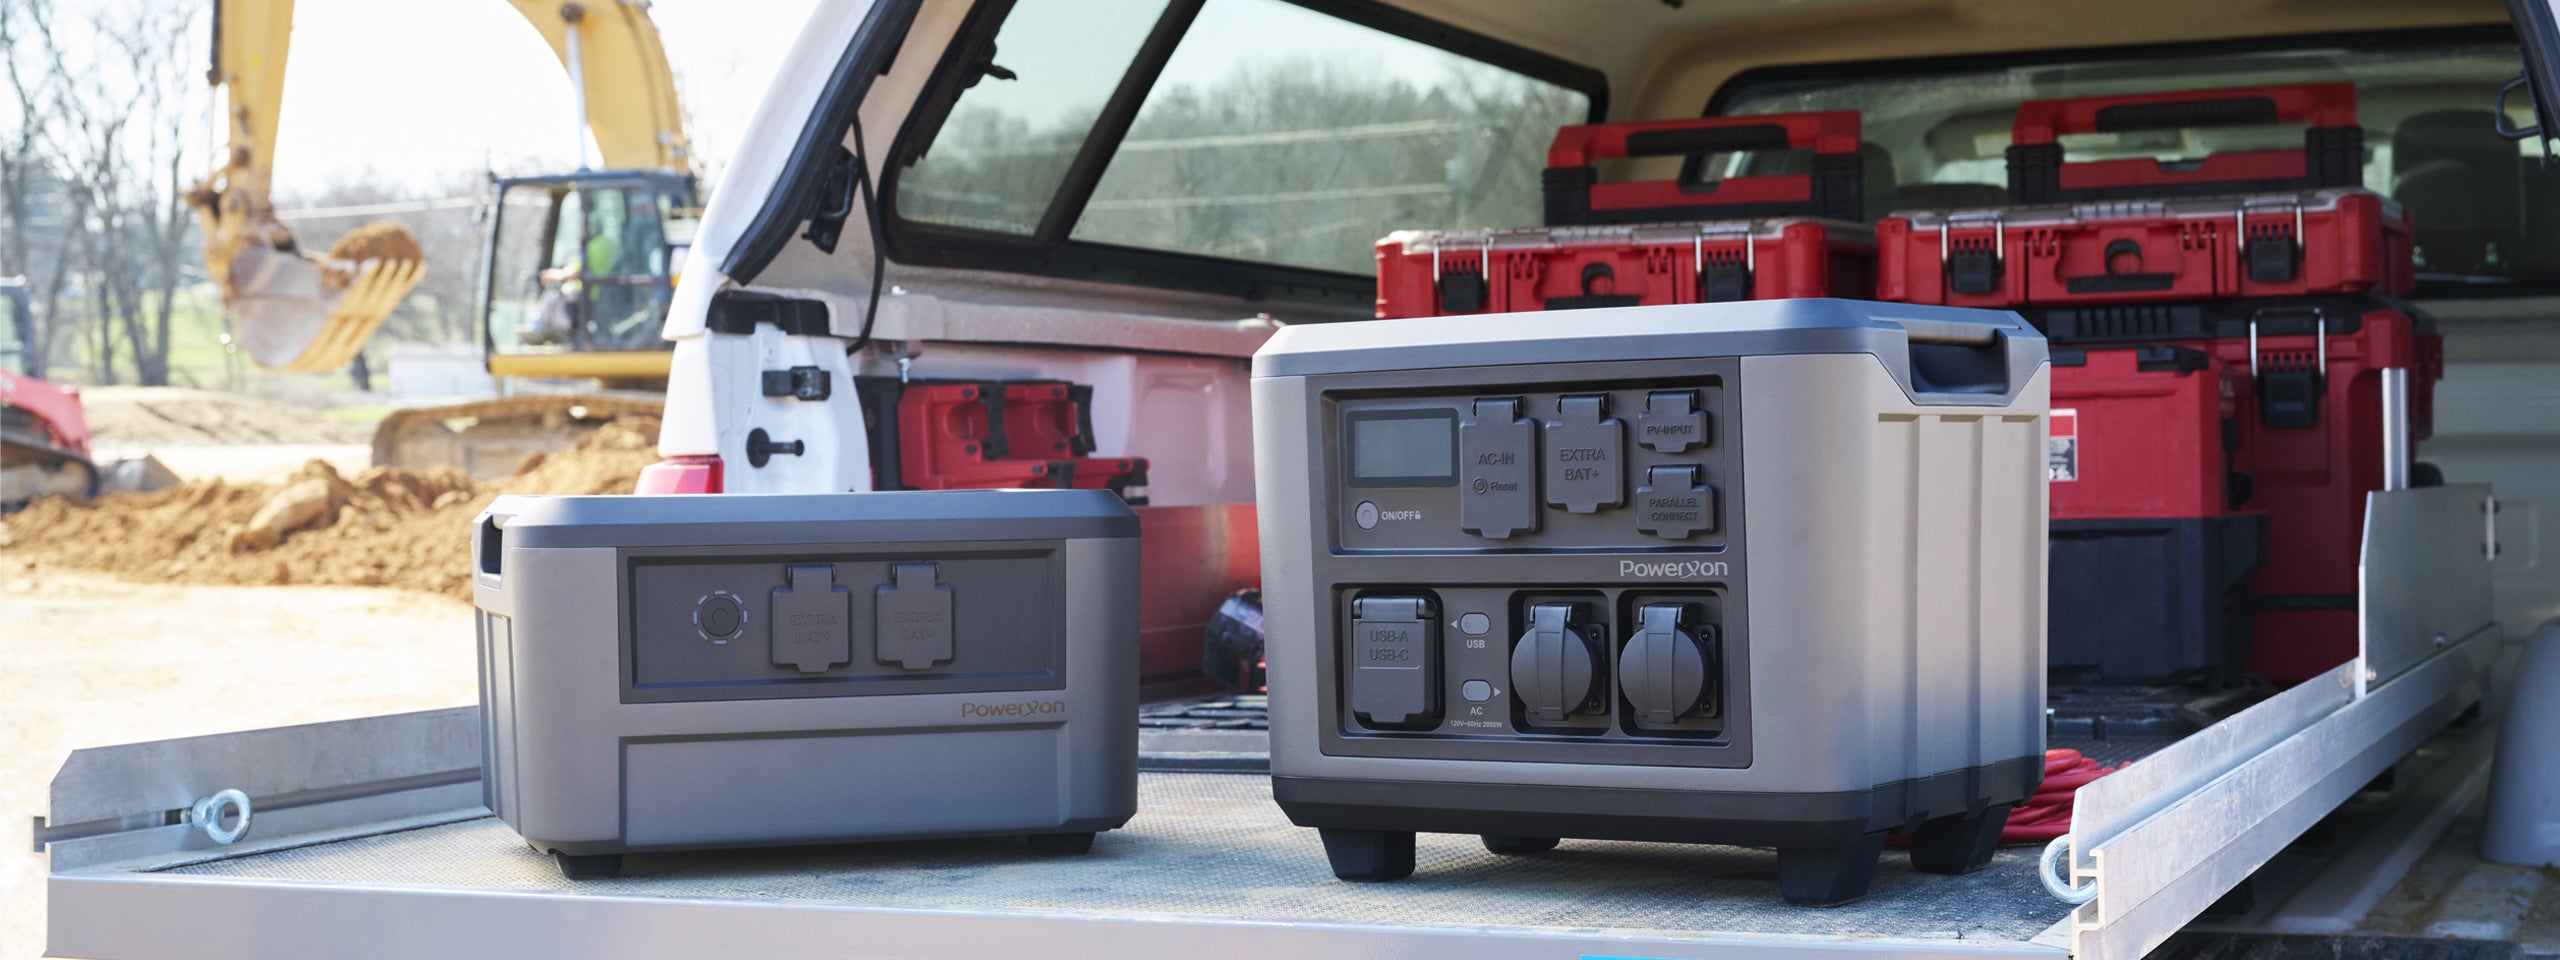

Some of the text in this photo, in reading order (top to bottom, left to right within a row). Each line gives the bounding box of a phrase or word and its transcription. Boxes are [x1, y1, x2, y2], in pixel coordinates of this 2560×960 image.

[1647, 424, 1693, 435] PV-INPUT
[1478, 452, 1515, 465] AC-IN
[1560, 448, 1606, 461] EXTRA
[1564, 468, 1600, 480] BAT+
[1490, 481, 1517, 492] Reset
[1649, 497, 1699, 508] PARALLEL
[1381, 510, 1415, 521] ON/OFF
[1651, 511, 1698, 521] CONNECT
[791, 613, 839, 626] EXTRA
[895, 611, 942, 623] EXTRA
[795, 631, 831, 643] BAT+
[1369, 630, 1409, 642] USB-A
[1466, 639, 1486, 649] USB
[1369, 648, 1409, 660] USB-C
[1470, 706, 1484, 716] AC
